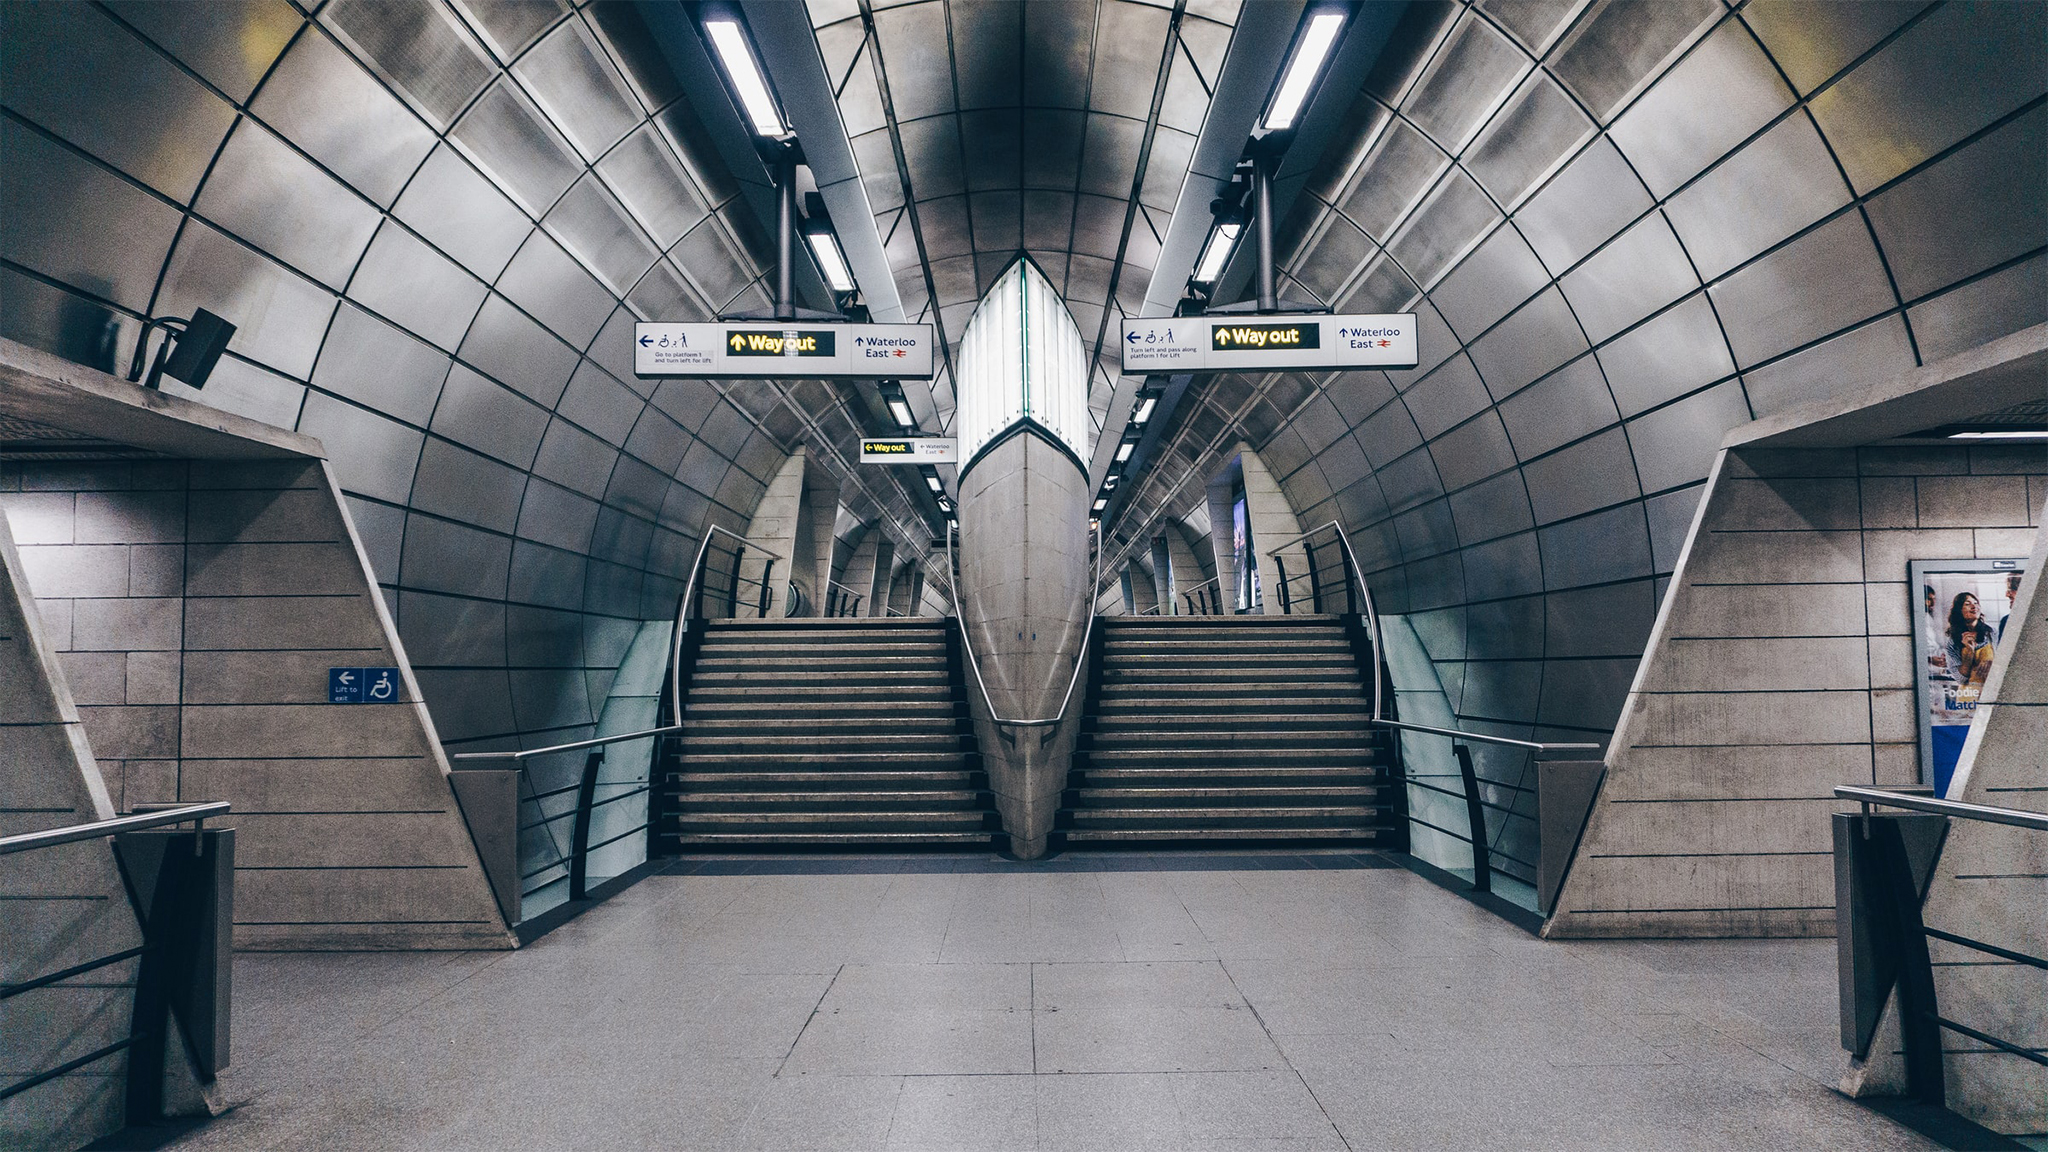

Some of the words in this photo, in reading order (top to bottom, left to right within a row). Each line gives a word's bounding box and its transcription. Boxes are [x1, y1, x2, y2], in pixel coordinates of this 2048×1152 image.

[1350, 327, 1401, 337] Waterloo
[866, 337, 917, 347] Waterloo
[1232, 328, 1268, 347] Way
[1269, 328, 1300, 344] out
[747, 334, 784, 354] Way
[786, 336, 817, 351] out
[1350, 339, 1374, 349] East
[866, 348, 890, 358] East
[873, 443, 890, 453] Way
[891, 444, 906, 452] out
[1943, 687, 1980, 698] Foodie
